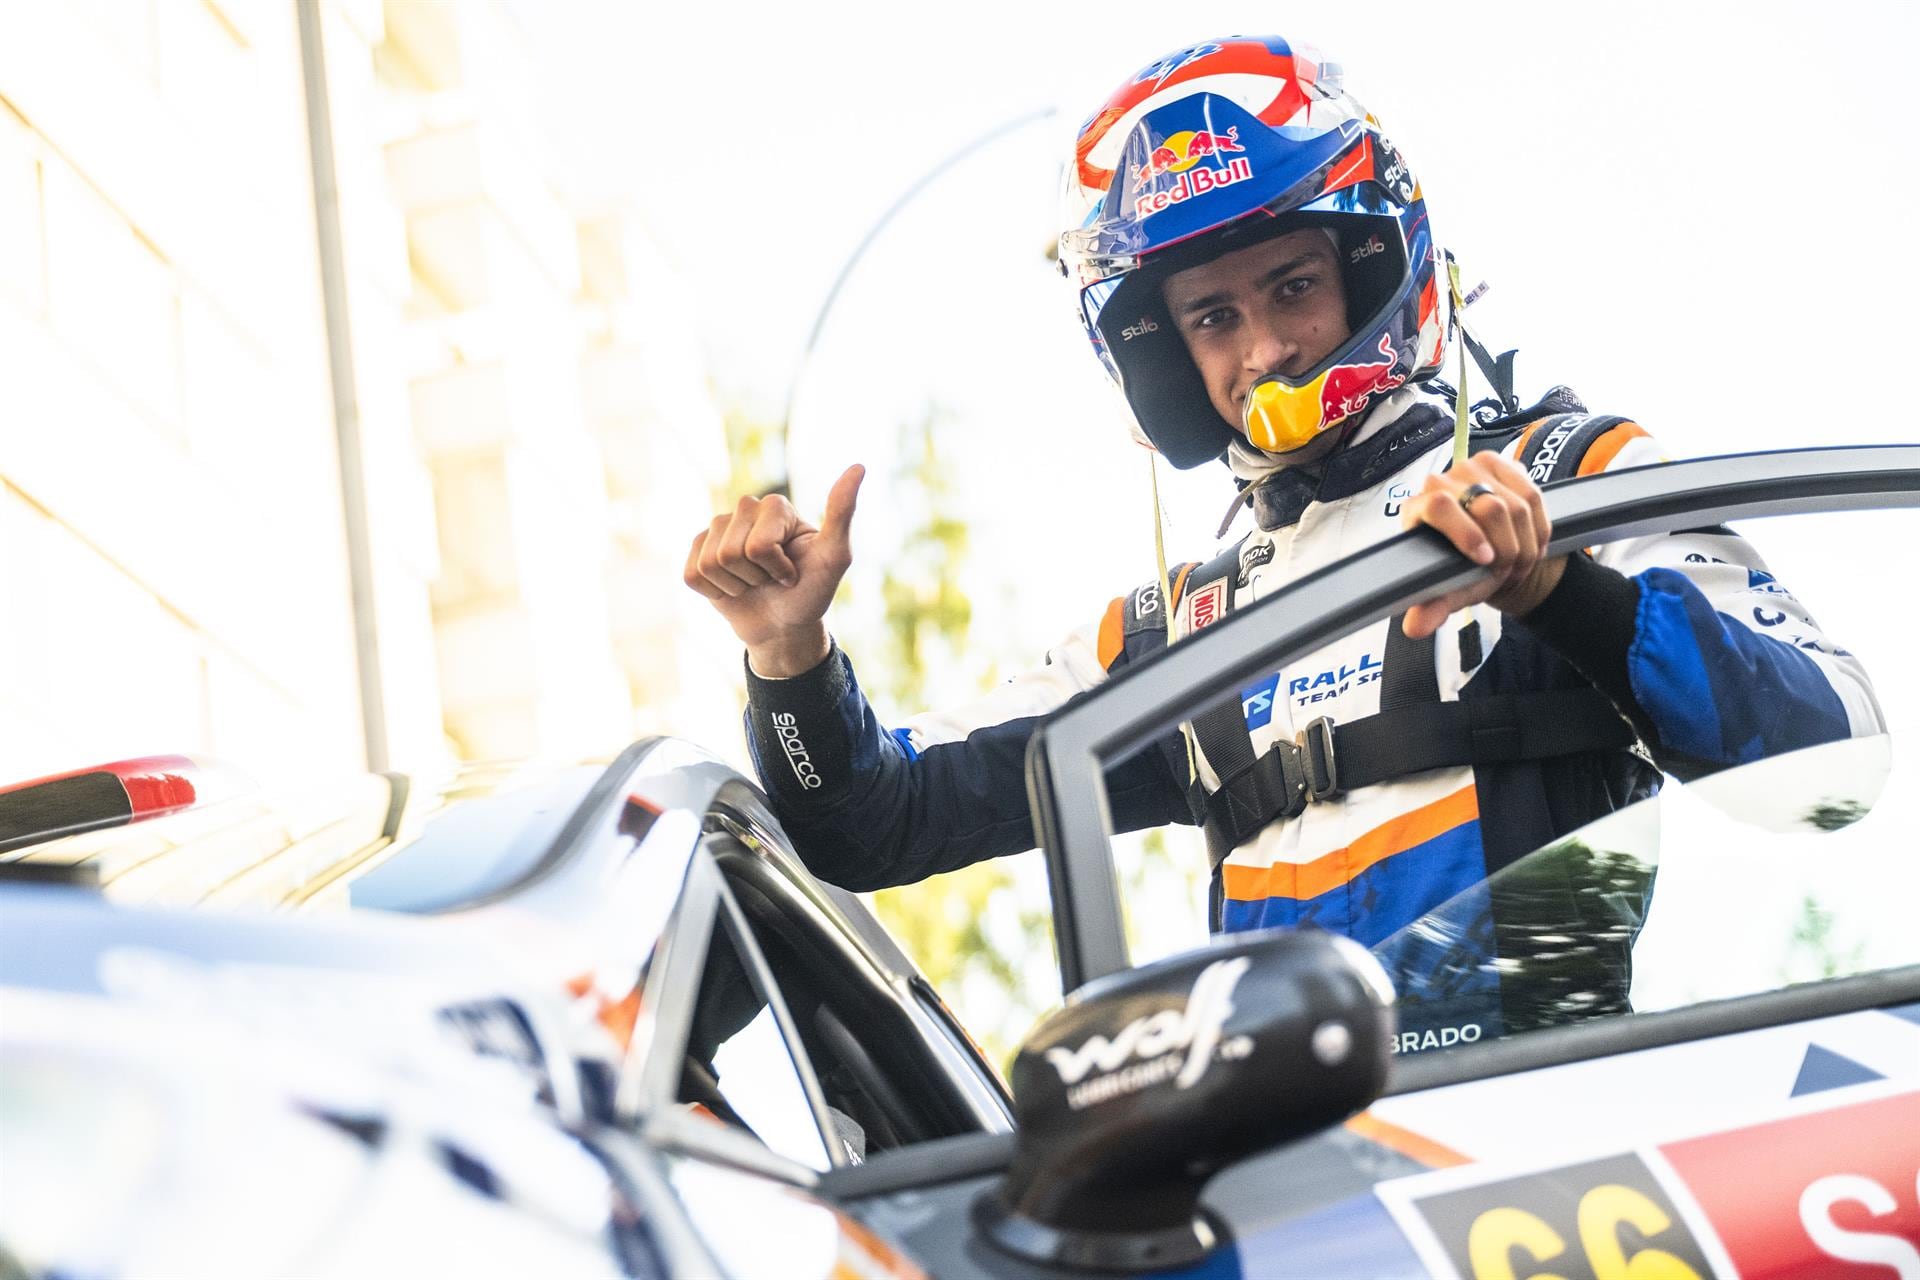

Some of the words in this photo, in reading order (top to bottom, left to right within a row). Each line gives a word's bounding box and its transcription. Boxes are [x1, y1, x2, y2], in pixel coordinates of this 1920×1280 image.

[1135, 172, 1191, 219] Red
[1189, 157, 1253, 196] Bull
[1351, 238, 1385, 264] stilo
[1121, 318, 1159, 341] stilo
[772, 712, 822, 790] sparco
[1799, 1174, 1920, 1280] S
